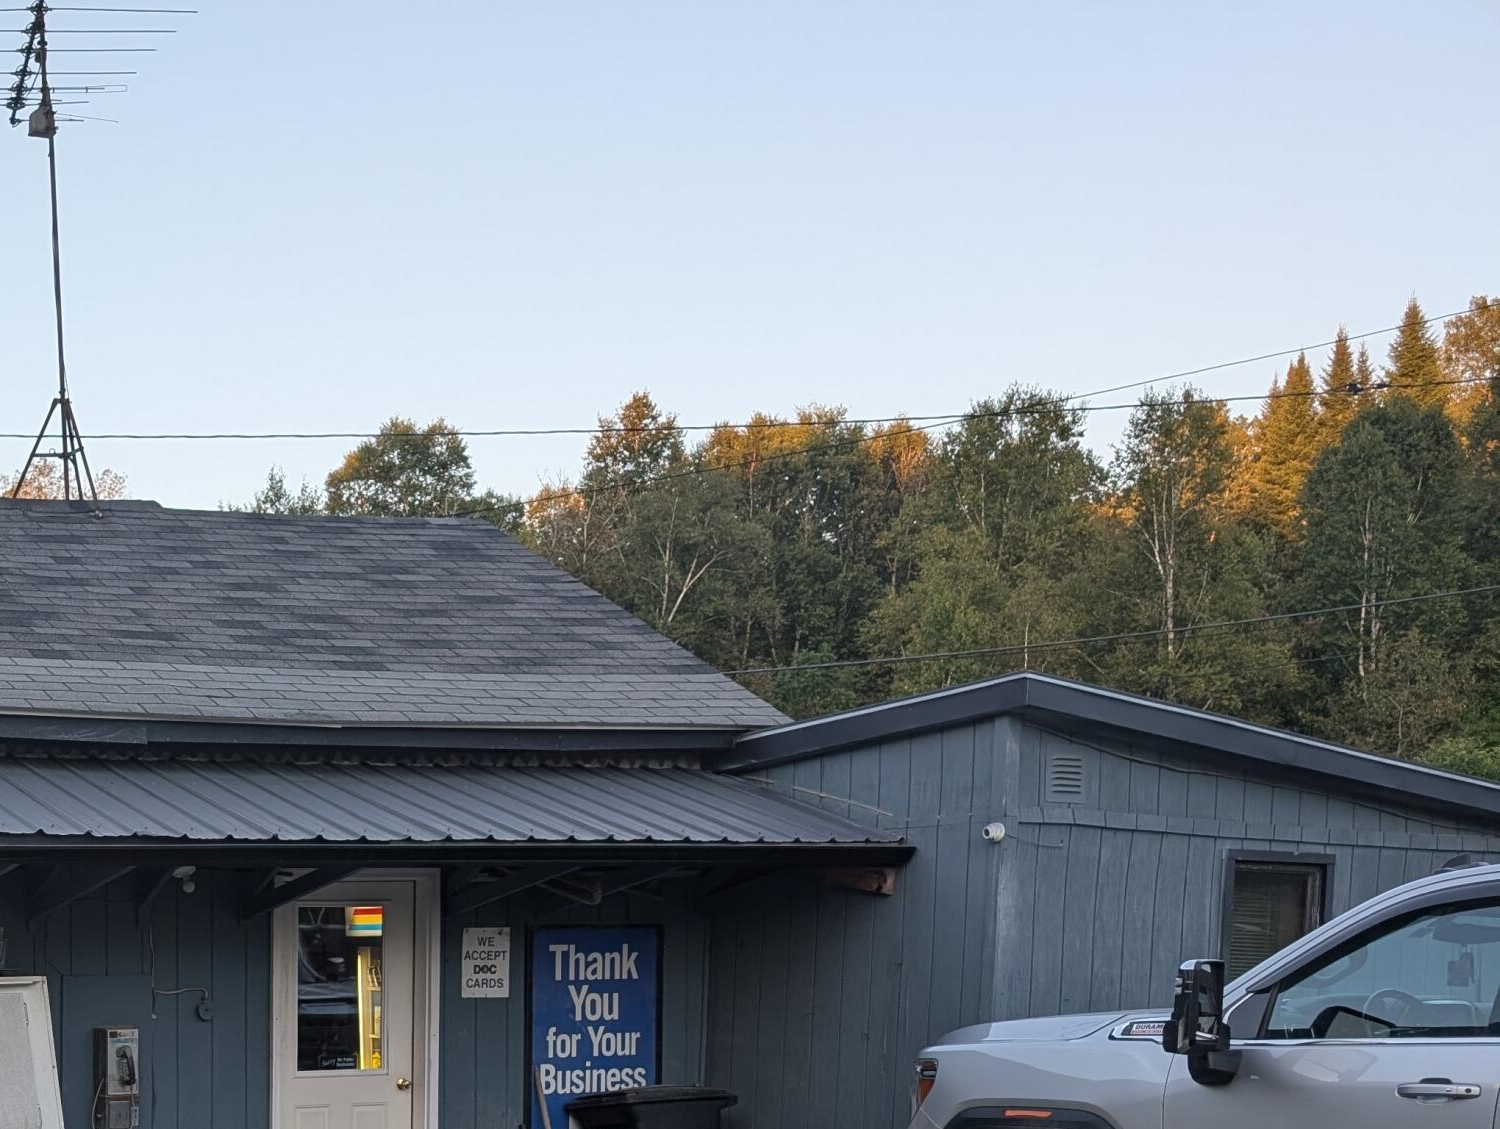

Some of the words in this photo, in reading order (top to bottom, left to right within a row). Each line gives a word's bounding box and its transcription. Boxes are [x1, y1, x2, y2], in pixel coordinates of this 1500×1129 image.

[463, 950, 508, 961] ACCEPT
[477, 936, 495, 947] WE
[548, 943, 639, 981] Thank
[466, 978, 504, 988] CARDS
[567, 984, 620, 1022] You
[546, 1026, 582, 1059] for
[587, 1025, 641, 1057] Your
[540, 1061, 647, 1095] Business
